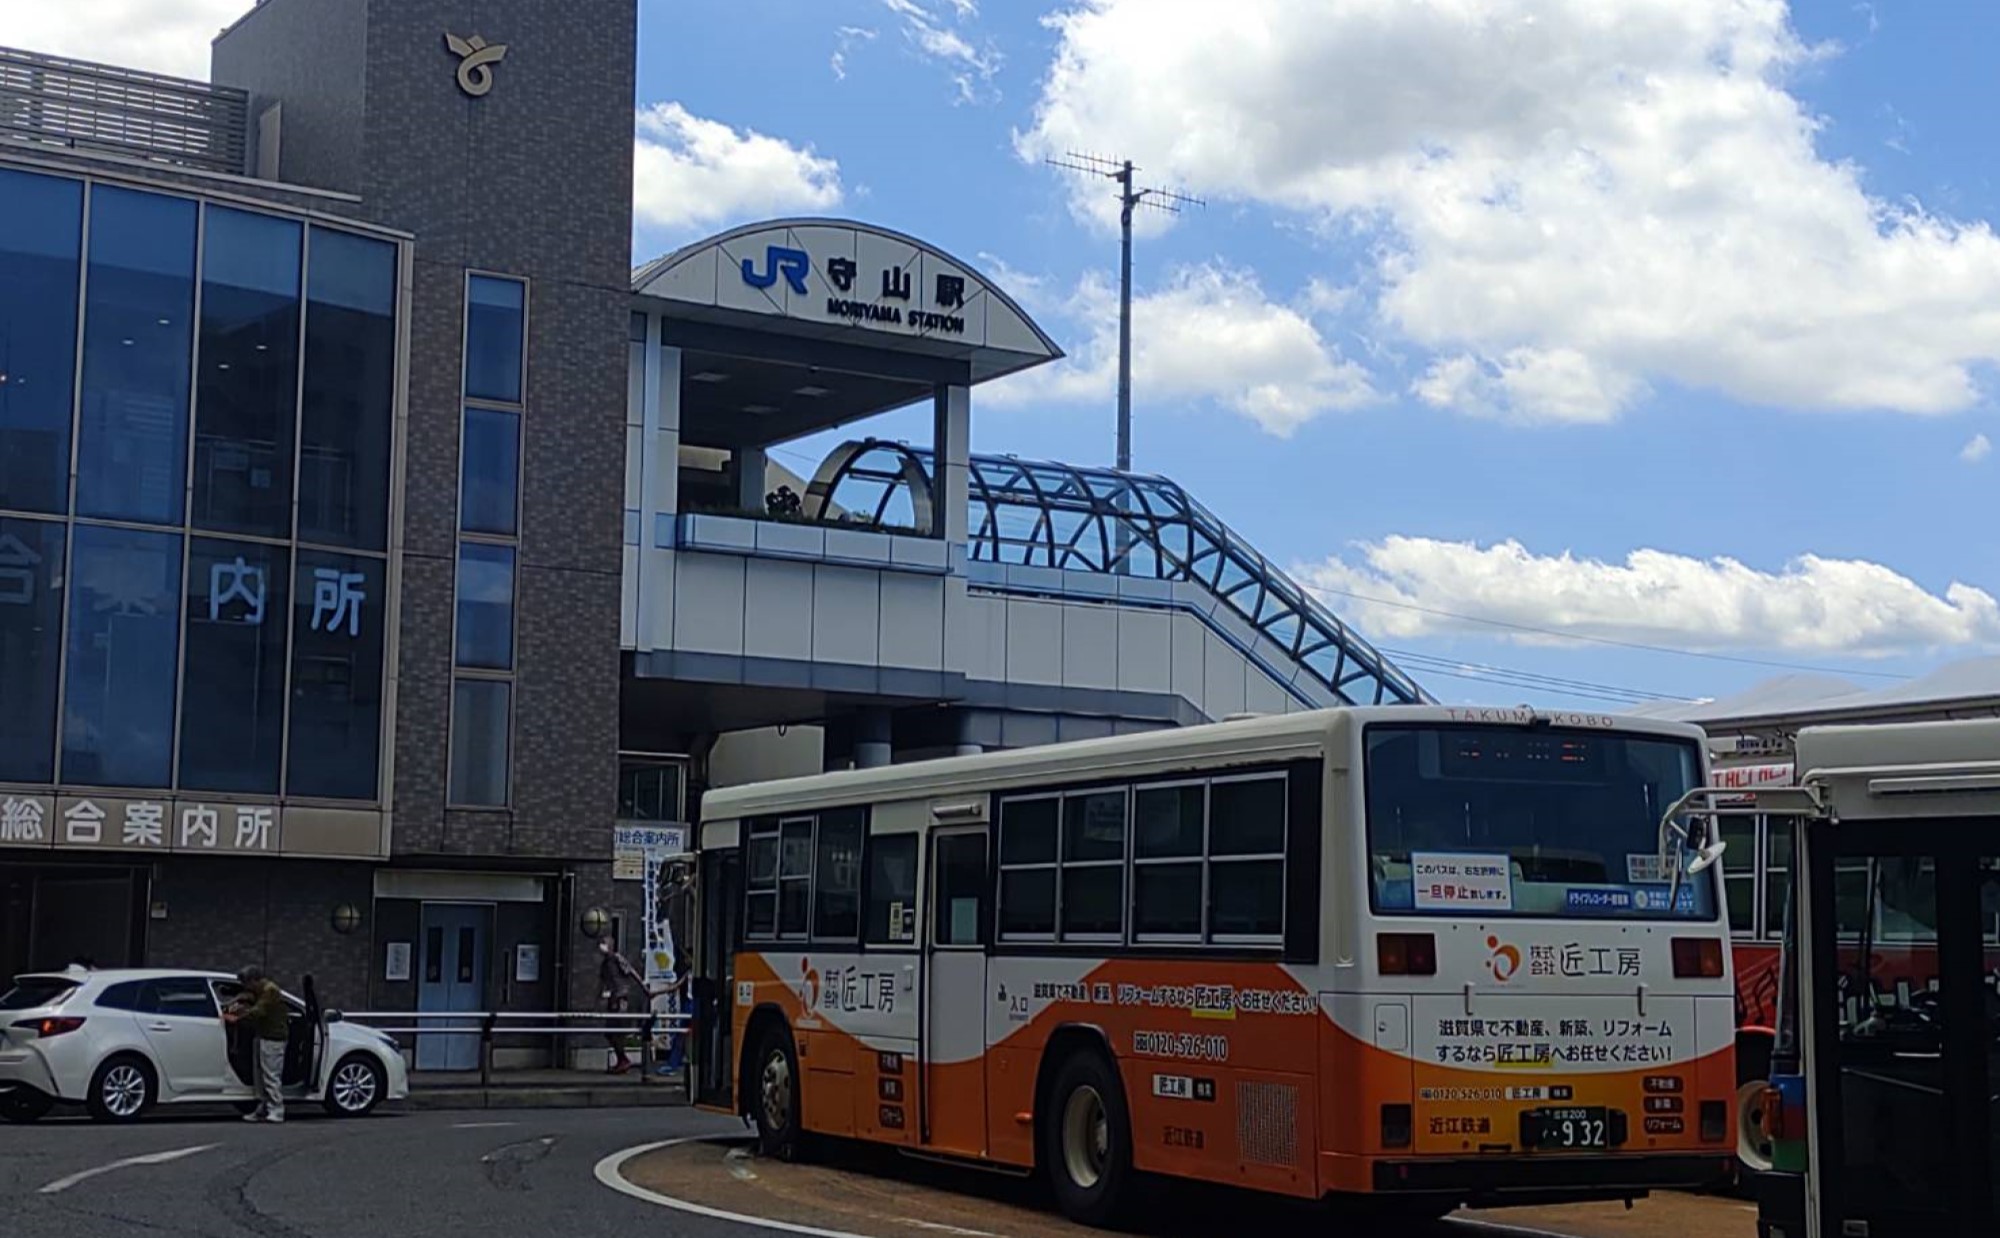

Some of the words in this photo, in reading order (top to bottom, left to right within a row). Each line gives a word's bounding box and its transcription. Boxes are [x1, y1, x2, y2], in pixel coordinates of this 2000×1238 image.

[742, 245, 809, 295] JR
[828, 257, 965, 309] 守山駅
[827, 298, 901, 324] MORIYAMA
[908, 310, 965, 333] STATION
[1446, 708, 1534, 724] TAKUM
[1553, 712, 1614, 728] KOBO
[1, 797, 273, 850] 総合案内所
[615, 829, 682, 848] 総合案内所
[1149, 1033, 1228, 1060] 0120-526-010
[1429, 1117, 1490, 1134] 近江鉄道
